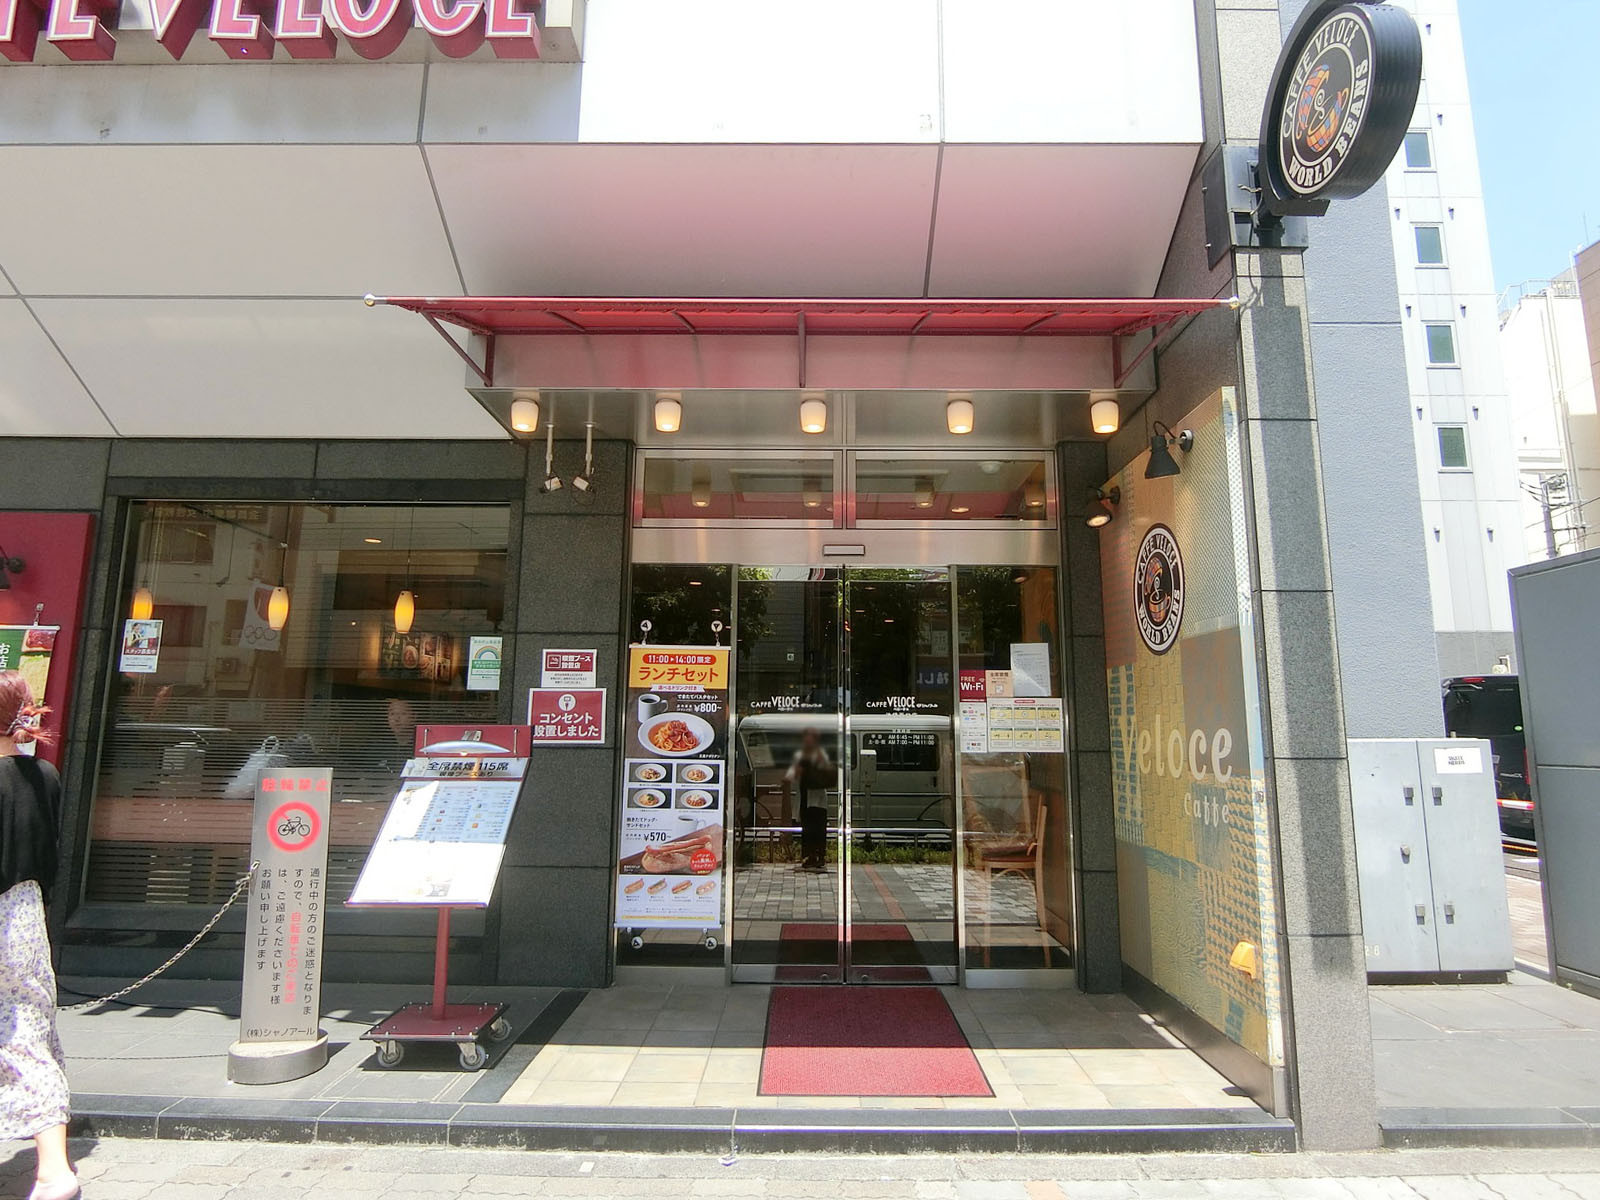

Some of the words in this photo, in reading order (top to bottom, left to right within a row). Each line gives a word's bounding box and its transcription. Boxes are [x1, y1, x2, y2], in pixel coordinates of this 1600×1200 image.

[1283, 51, 1314, 139] CAFFE
[1314, 18, 1360, 53] VELOCE
[1289, 154, 1333, 187] WORLD
[1337, 59, 1369, 158] BEANS
[1138, 537, 1155, 584] CAFFE
[1156, 535, 1178, 570] VELOCE
[1138, 603, 1160, 644] WORLD
[1163, 589, 1180, 641] BEANS
[648, 655, 669, 663] 11:00
[638, 666, 719, 682] ランチセット
[960, 682, 984, 691] Wi-Fi
[771, 696, 800, 708] VELOCE
[887, 696, 916, 708] VELOCE
[539, 712, 593, 724] コンセント
[533, 724, 599, 737] 設置しました
[256, 868, 272, 971] お願い申し上げます
[270, 868, 287, 1006] は、ご遠慮くださいます様
[303, 867, 321, 1016] 通行中の方のご迷惑となりま
[246, 1026, 316, 1040] (株)シャノアール
